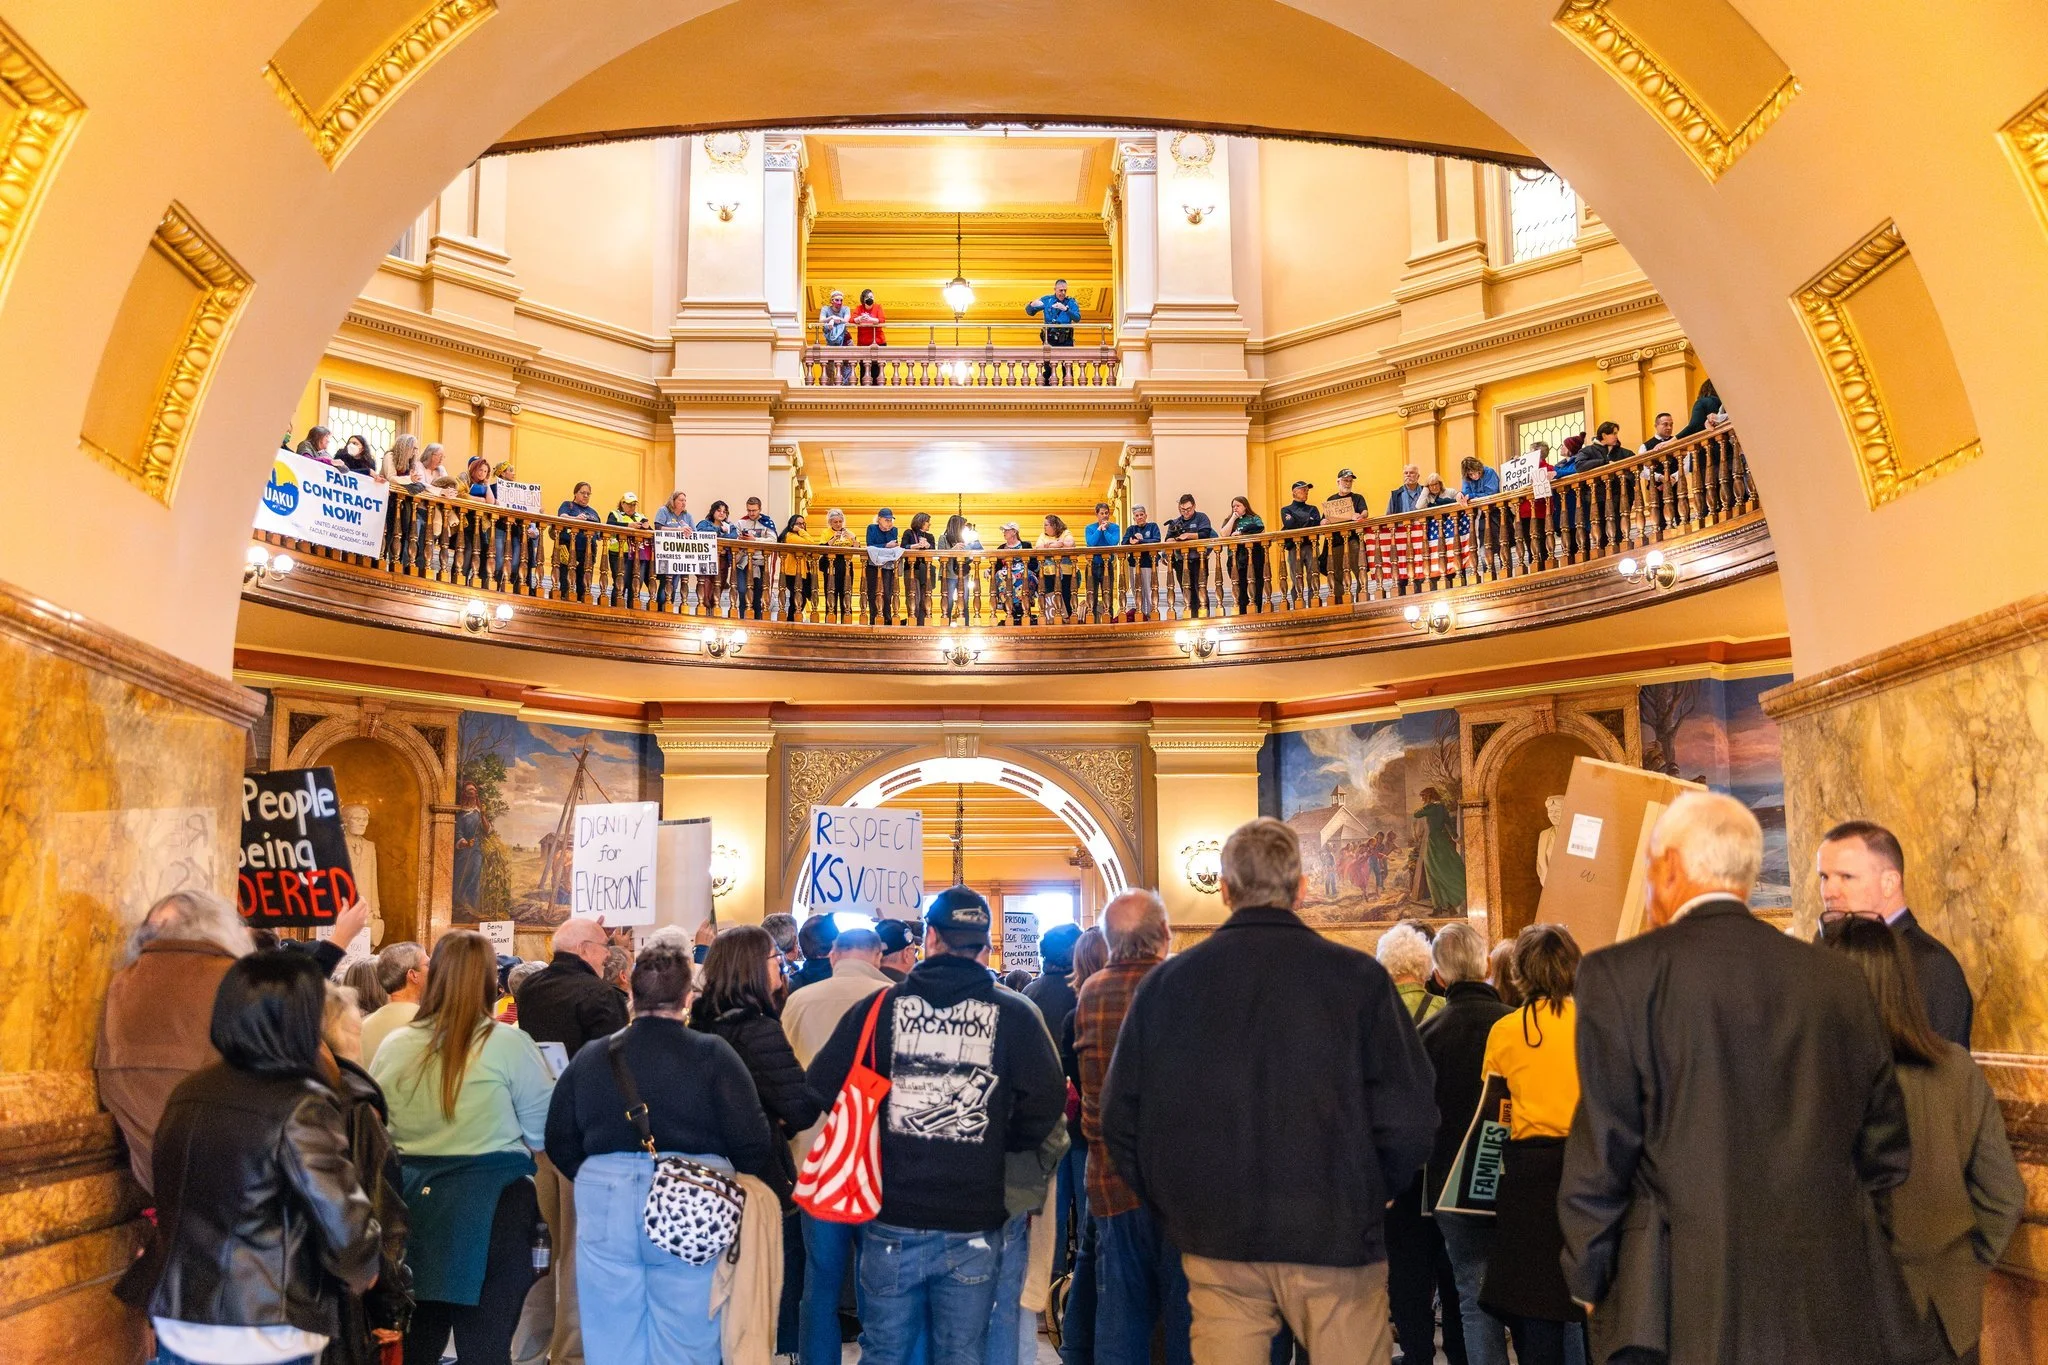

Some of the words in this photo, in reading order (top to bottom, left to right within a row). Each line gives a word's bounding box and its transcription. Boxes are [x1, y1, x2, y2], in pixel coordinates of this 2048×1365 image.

[326, 470, 358, 490] FAIR
[1505, 465, 1534, 481] Roger
[506, 482, 527, 490] STAND
[264, 486, 294, 508] UAKU
[303, 481, 383, 512] CONTRACT
[498, 487, 542, 507] STOLEN
[323, 503, 362, 525] NOW!
[309, 527, 328, 536] FACULTY
[339, 534, 361, 544] ACADEMIC
[314, 520, 331, 528] UNITED
[332, 524, 354, 535] ACADEMICS
[676, 532, 698, 540] NEER
[663, 541, 710, 553] COWARDS
[673, 562, 697, 573] QUIET
[243, 772, 336, 836] People
[580, 815, 645, 848] DIGNITY
[816, 811, 921, 852] RESPECT
[597, 844, 622, 862] for
[575, 866, 649, 913] EVERYONE
[811, 852, 844, 904] KS
[846, 866, 921, 909] VOTERS
[487, 923, 503, 931] Being
[1005, 915, 1027, 924] PRISON
[1005, 934, 1017, 942] DUE
[899, 1018, 992, 1039] VACATION
[1473, 1125, 1507, 1197] FAMILIES
